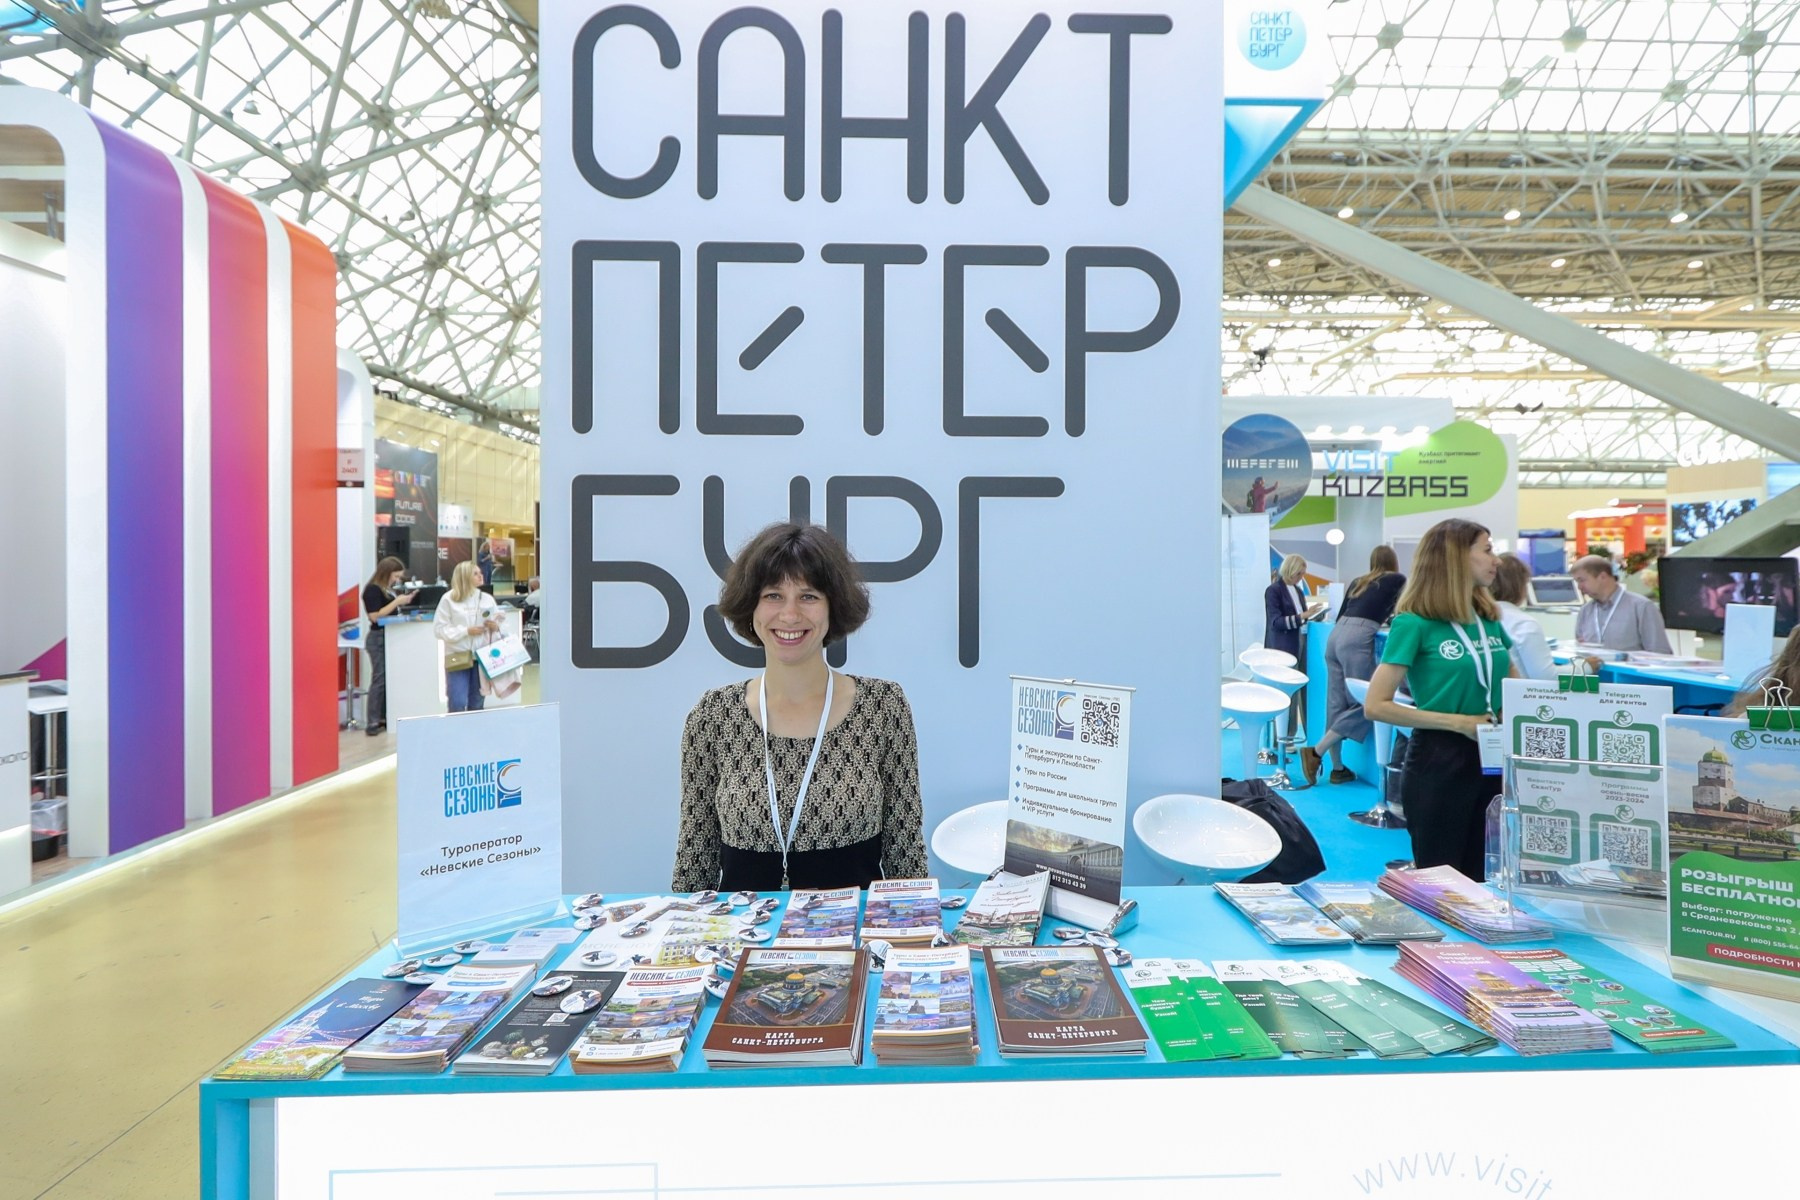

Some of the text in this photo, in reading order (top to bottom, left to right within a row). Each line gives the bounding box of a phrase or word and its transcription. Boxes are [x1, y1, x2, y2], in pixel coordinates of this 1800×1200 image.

[1250, 11, 1292, 25] САНКТ
[1250, 27, 1293, 41] ПЕТЕР
[1249, 43, 1284, 57] БУРГ
[572, 5, 1174, 207] САНКТ
[572, 239, 1181, 438] ПЕТЕР
[1227, 458, 1298, 469] ШЕРЕГЕШ
[1323, 450, 1399, 473] VISIT
[1322, 475, 1469, 497] KUZBASS
[395, 500, 422, 511] FUTURE
[572, 475, 1065, 670] БУРГ
[1019, 686, 1056, 710] НЕВСКИЕ
[1017, 707, 1055, 738] СЕЗОНЫ
[1024, 753, 1055, 766] Петербургу
[1061, 759, 1096, 771] Ленобласти
[1025, 746, 1039, 754] Туры
[1044, 749, 1074, 762] экскурсии
[1083, 755, 1103, 764] Санкт-
[444, 762, 495, 789] НЕВСКИЕ
[1024, 767, 1037, 776] Туры
[1046, 771, 1067, 781] России
[444, 784, 496, 818] СЕЗОНЫ
[1023, 782, 1117, 808] Программы для школьных групп
[1022, 797, 1112, 823] Индивидуальное бронирование
[1036, 809, 1055, 818] услуги
[441, 834, 523, 858] Туроператор
[420, 846, 541, 877] «Невские Сезоны»
[1681, 868, 1793, 893] РОЗЫГРЫШ
[1681, 902, 1792, 925] Выборг: погружение
[1690, 911, 1772, 930] Средневековье
[1682, 926, 1736, 940] SCANTOUR.RU
[1714, 947, 1794, 967] ПОДРОБНОСТИ
[732, 1037, 824, 1046] САНКТ-ПЕТЕРБУРГА
[1027, 1029, 1118, 1039] САНКТ-ПЕТЕРБУРГА
